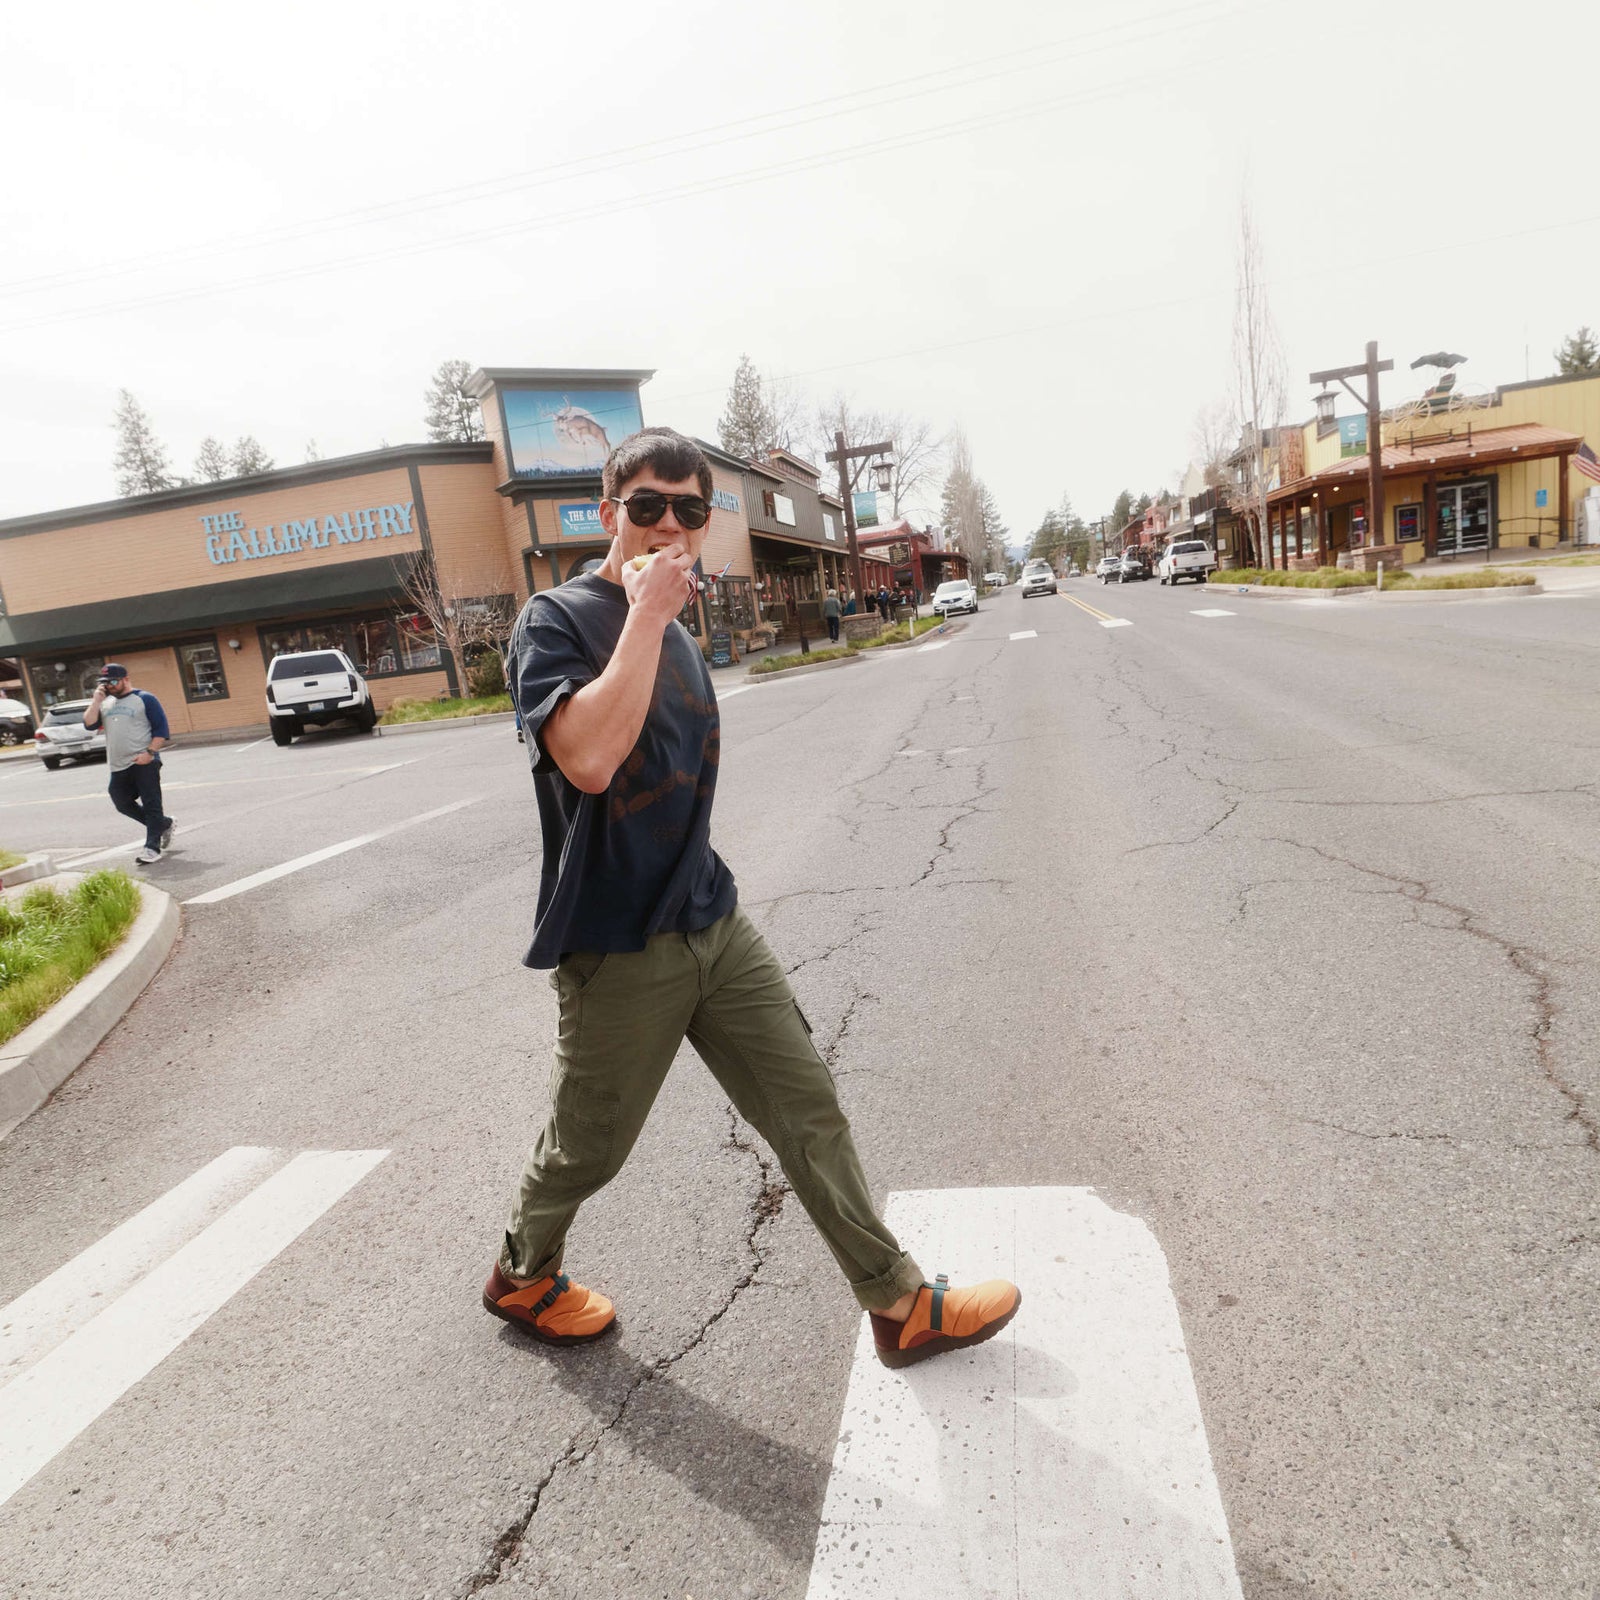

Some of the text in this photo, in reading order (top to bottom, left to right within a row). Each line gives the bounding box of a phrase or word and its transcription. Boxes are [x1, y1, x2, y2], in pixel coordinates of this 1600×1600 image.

[201, 510, 245, 535] THE
[568, 510, 585, 522] THE
[205, 501, 414, 564] GALLIMAUFRY
